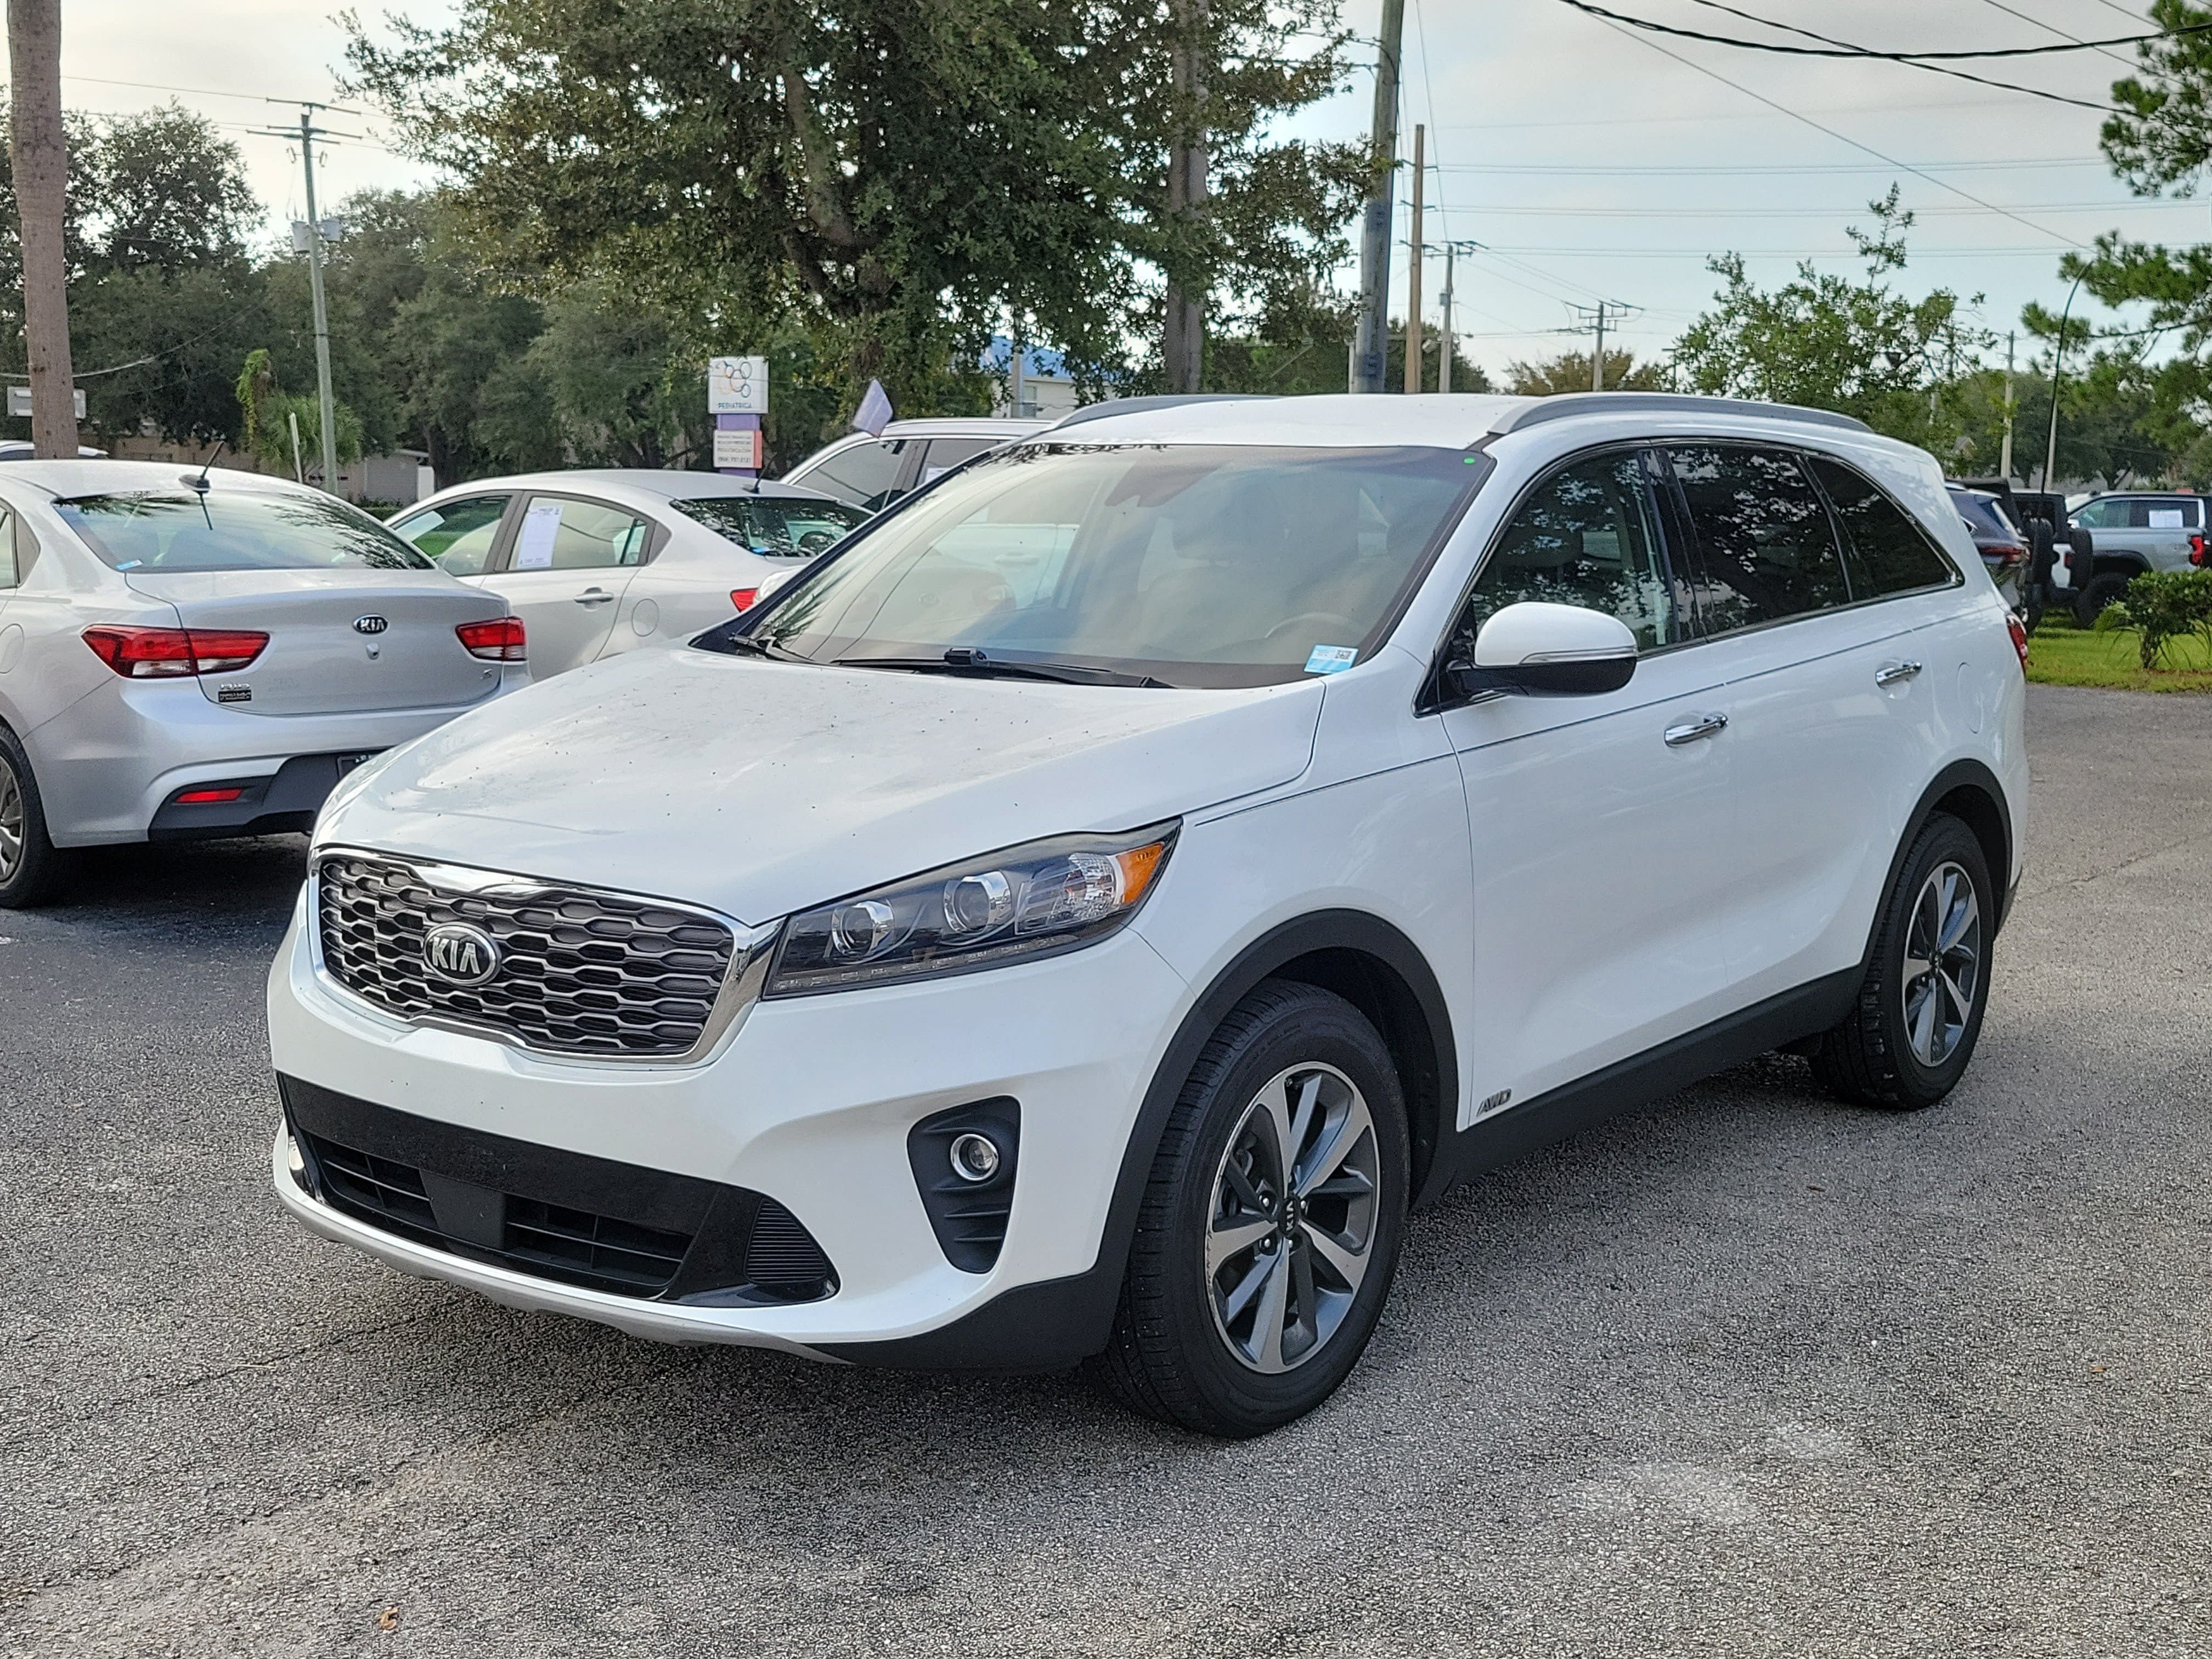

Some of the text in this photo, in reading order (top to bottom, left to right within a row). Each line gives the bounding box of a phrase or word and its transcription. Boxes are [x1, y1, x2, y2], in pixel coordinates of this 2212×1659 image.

[360, 618, 385, 631] KIA
[432, 936, 481, 974] KIA
[1476, 1088, 1511, 1117] AWD
[1286, 1200, 1294, 1231] KIA
